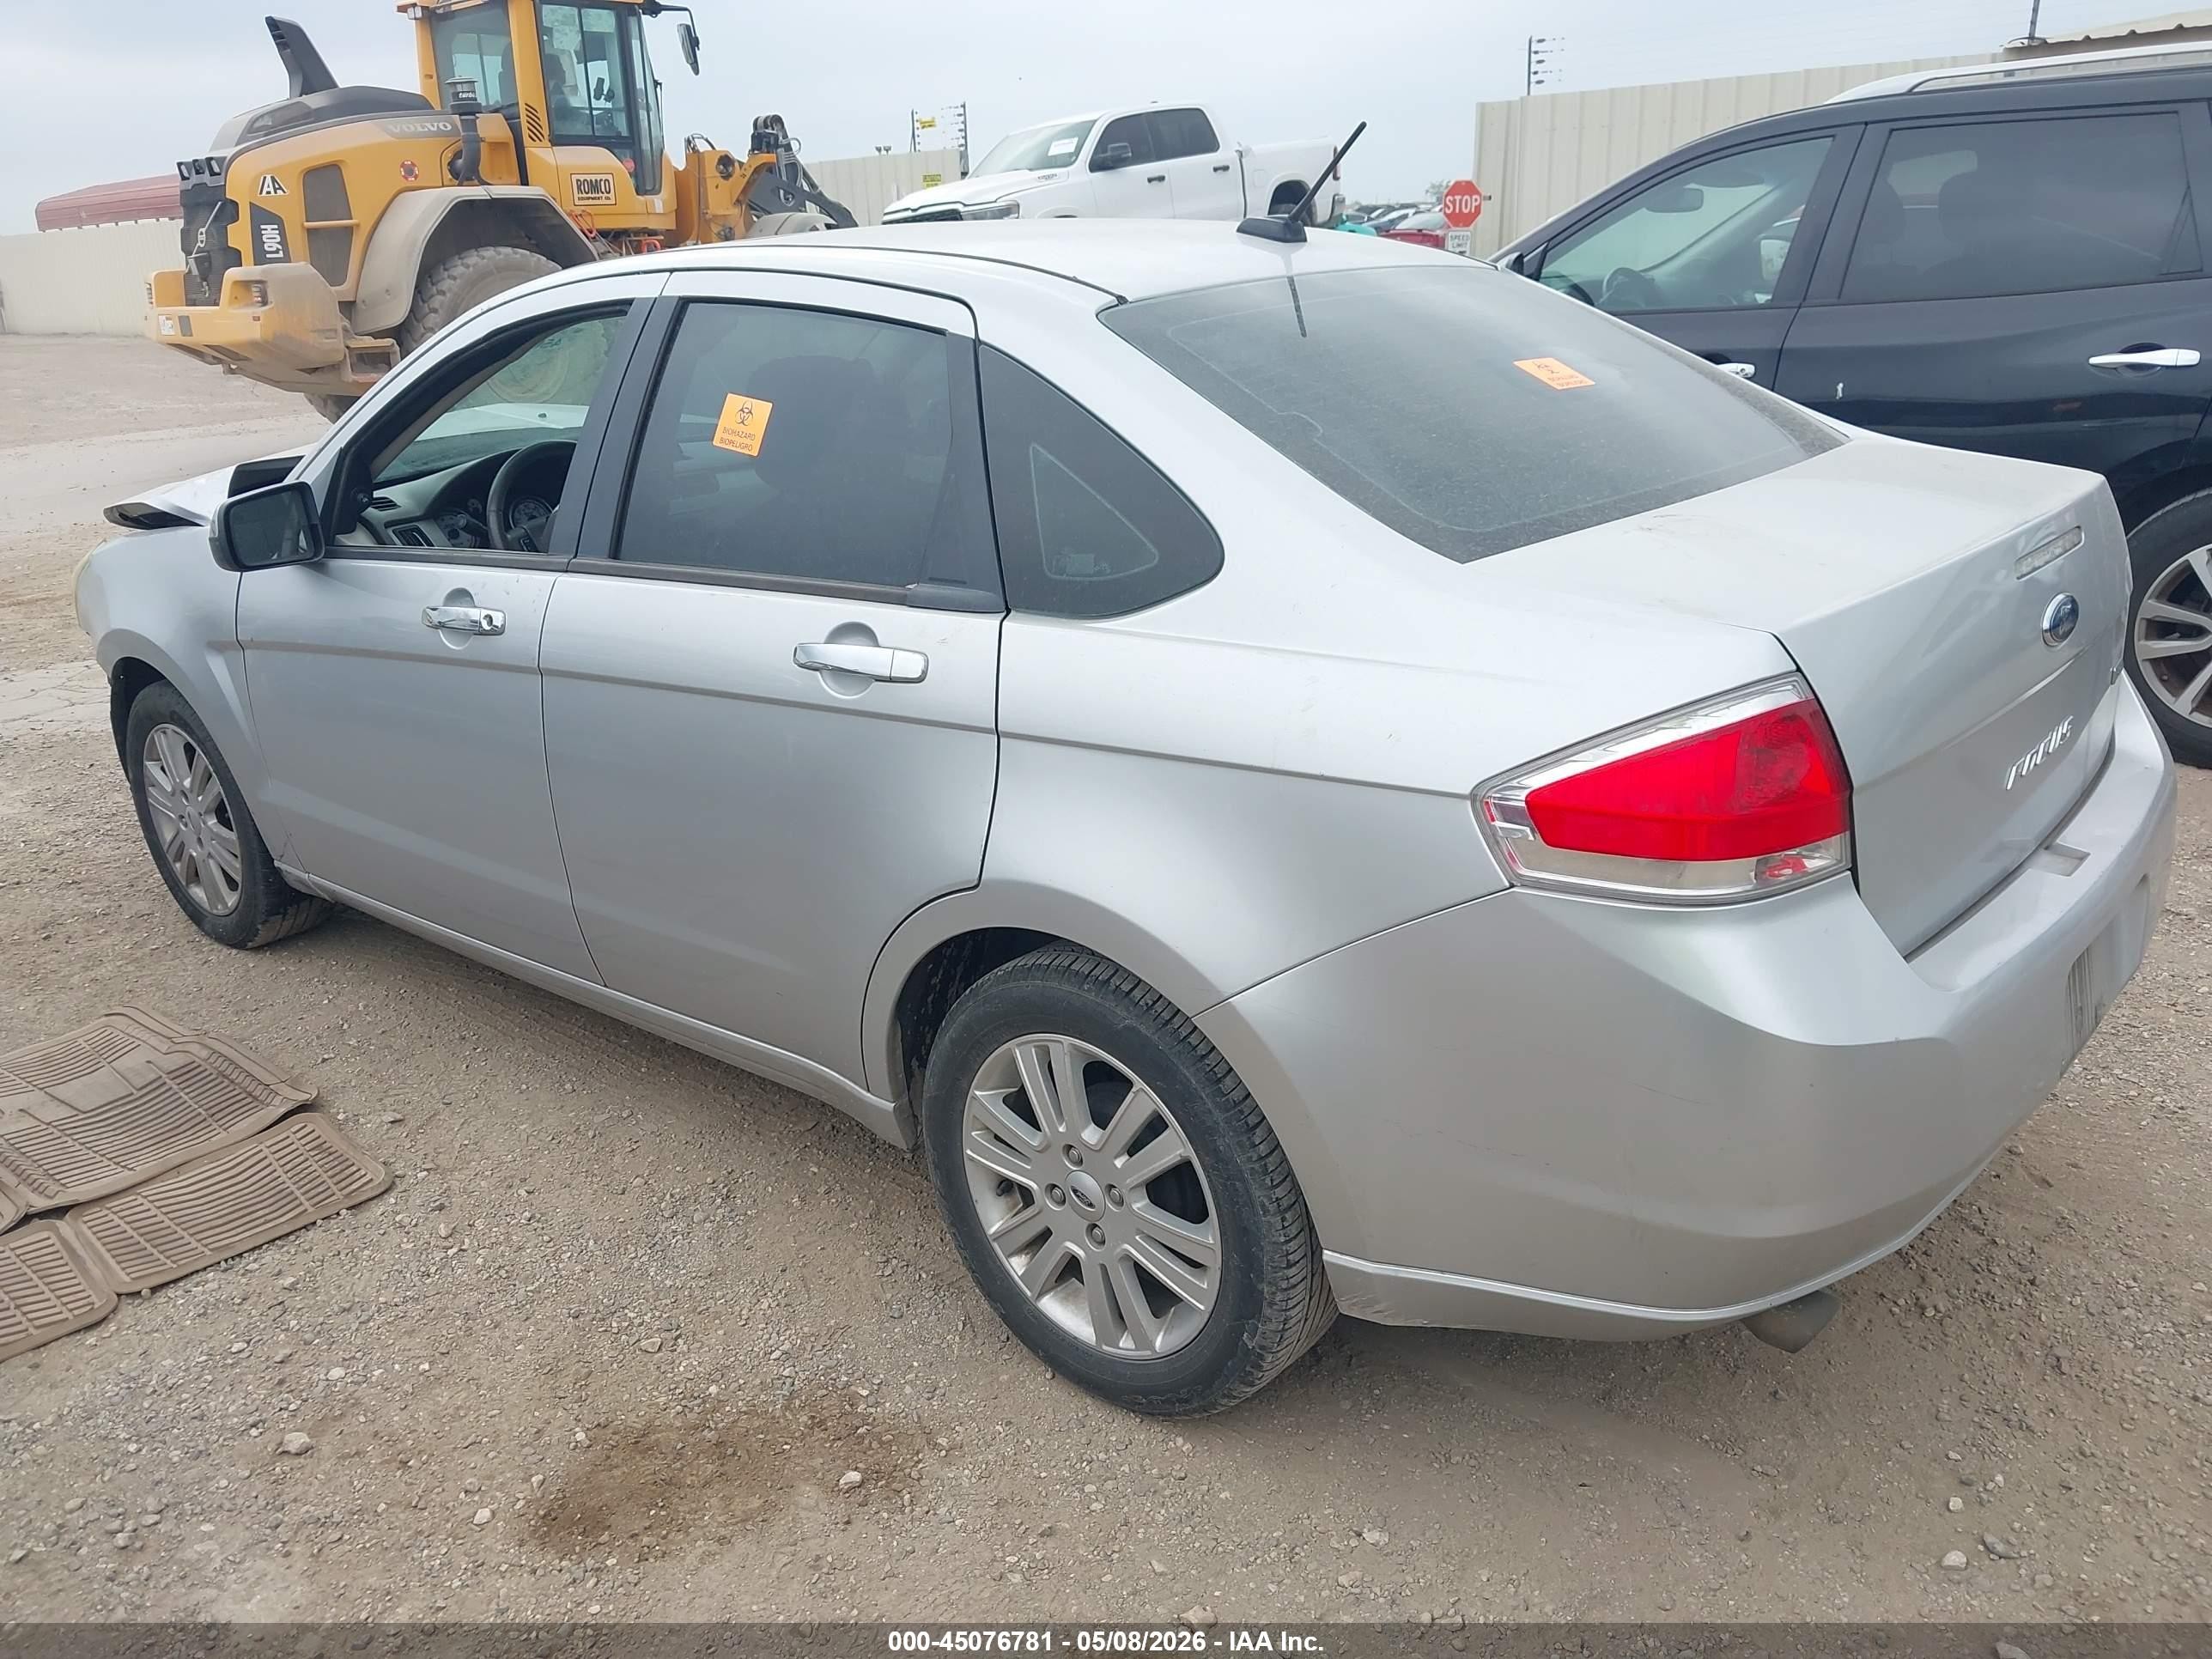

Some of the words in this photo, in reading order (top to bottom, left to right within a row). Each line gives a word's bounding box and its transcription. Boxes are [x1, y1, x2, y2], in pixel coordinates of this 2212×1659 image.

[386, 122, 453, 131] VOLVO
[575, 178, 611, 195] ROMCO
[1444, 194, 1481, 214] STOP
[259, 224, 284, 258] L90H
[722, 426, 757, 441] BIOHAZARD
[719, 436, 754, 453] BIOPELIGRO
[2006, 714, 2074, 790] FOCUS
